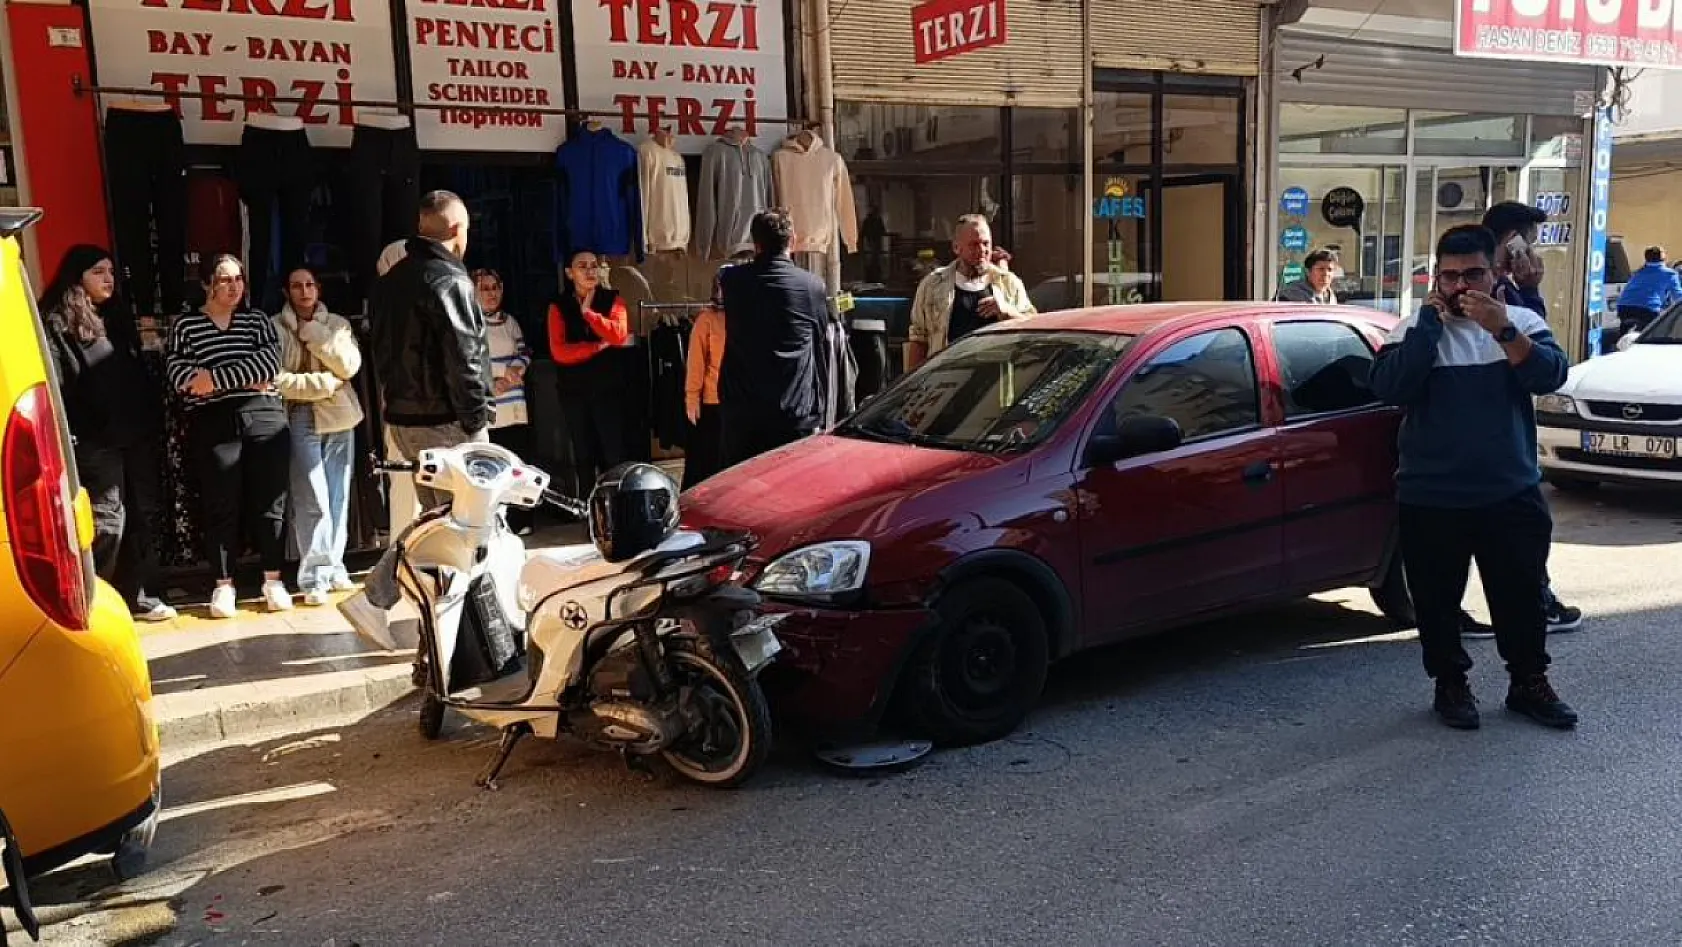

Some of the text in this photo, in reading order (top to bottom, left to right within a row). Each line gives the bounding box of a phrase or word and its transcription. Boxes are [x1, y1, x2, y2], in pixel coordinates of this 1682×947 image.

[415, 18, 555, 53] PENYECİ
[600, 0, 759, 50] TERZİ
[148, 30, 213, 56] BAY
[246, 37, 351, 64] BAYAN
[446, 58, 529, 79] TAILOR
[612, 60, 658, 80] BAY
[681, 63, 756, 84] BAYAN
[150, 68, 355, 126] TERZİ
[428, 83, 550, 105] SCHNEIDER
[613, 88, 757, 137] TERZİ
[1645, 437, 1673, 454] 070
